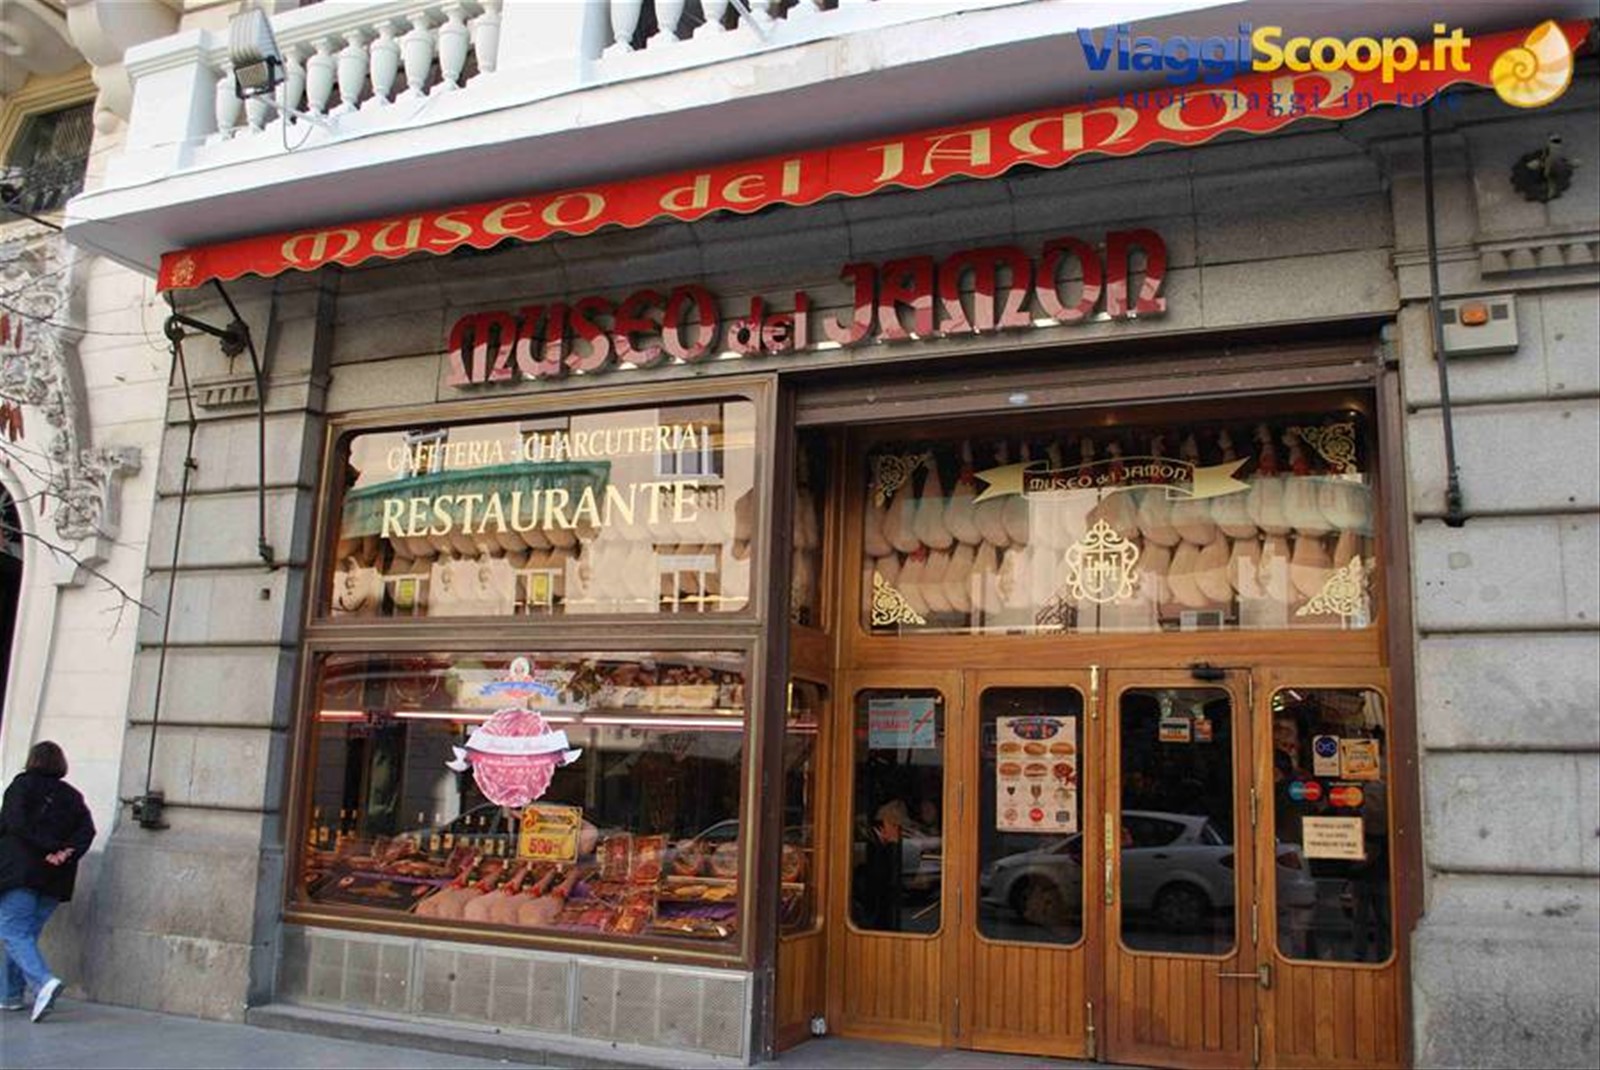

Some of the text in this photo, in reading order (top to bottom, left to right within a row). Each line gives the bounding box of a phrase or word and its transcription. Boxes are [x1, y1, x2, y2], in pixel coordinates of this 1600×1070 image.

[660, 159, 802, 213] del
[727, 293, 808, 356] del
[823, 228, 1168, 347] JAMON
[524, 424, 698, 460] CHARCUTERIA
[380, 479, 700, 539] RESTAURANTE
